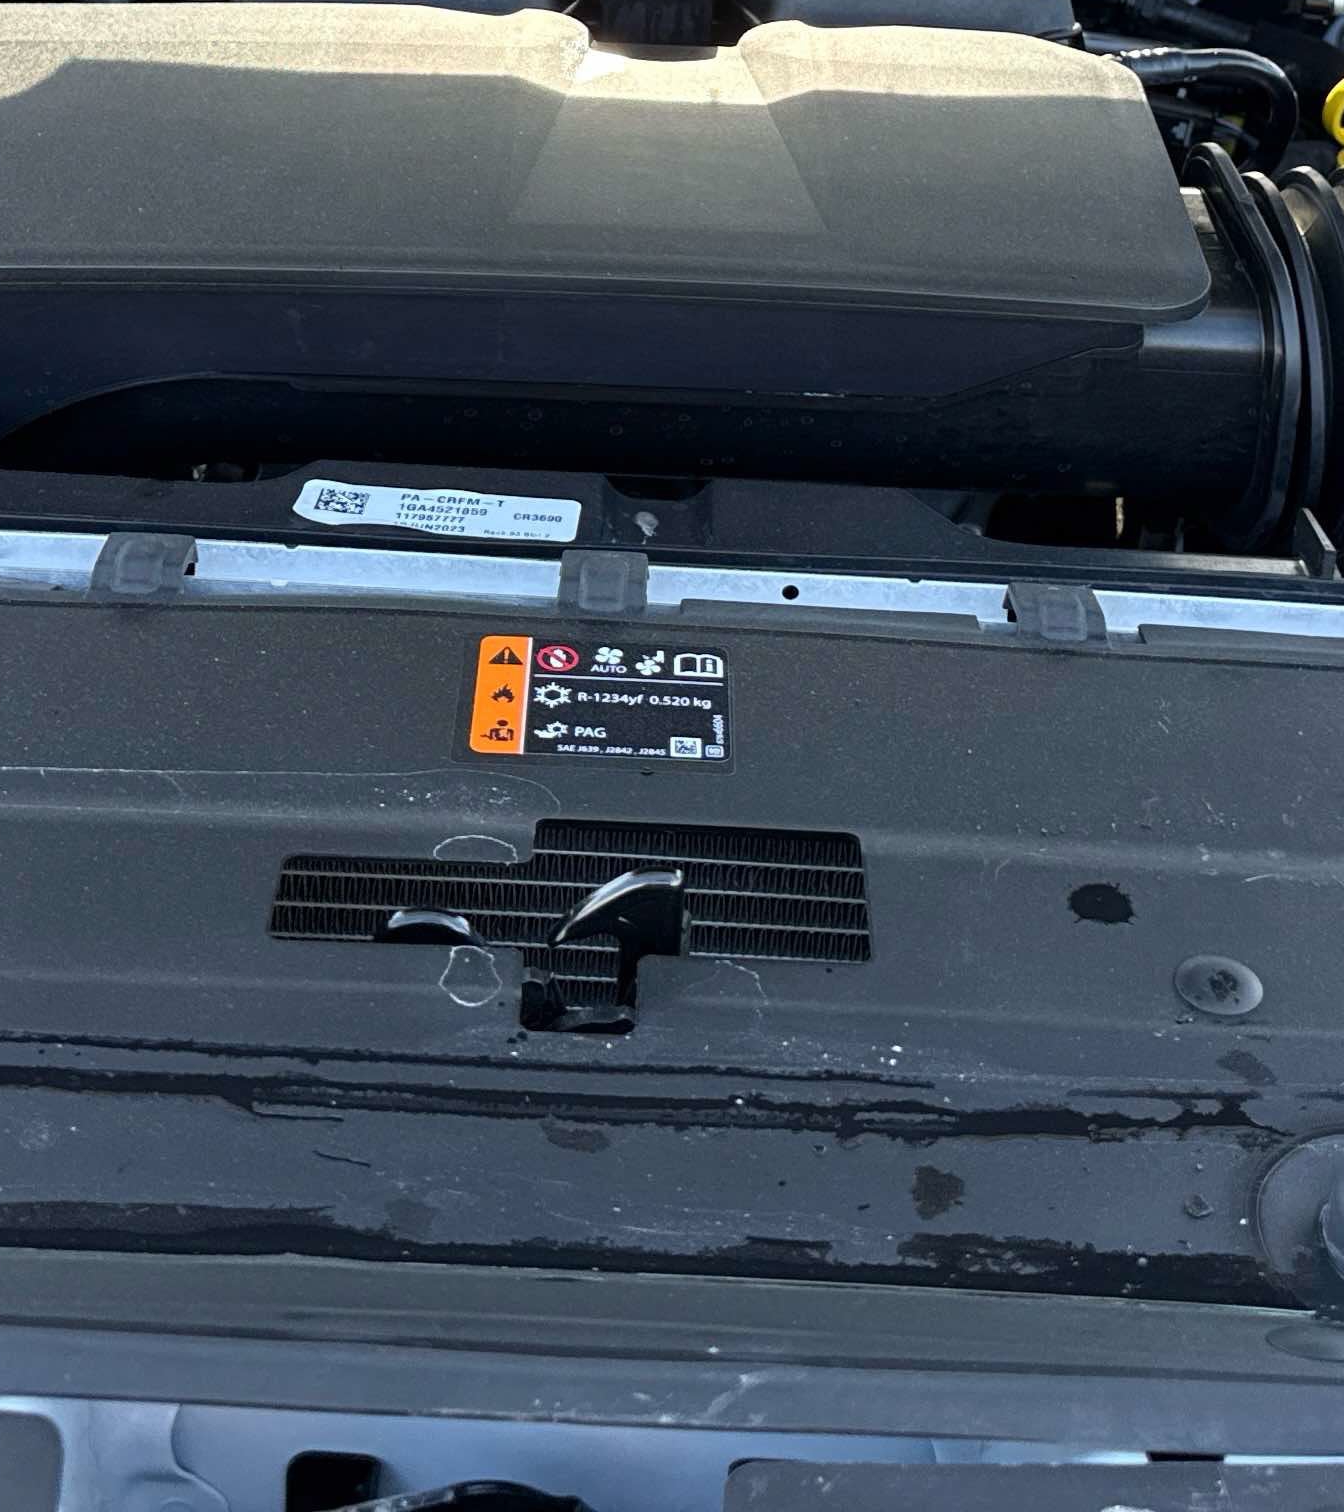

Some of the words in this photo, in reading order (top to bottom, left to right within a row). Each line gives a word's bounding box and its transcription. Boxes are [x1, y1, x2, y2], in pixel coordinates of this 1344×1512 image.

[590, 663, 627, 674] AUTO
[577, 692, 644, 706] R-1234yf
[649, 695, 690, 706] 0.520
[692, 697, 712, 709] kg
[574, 726, 607, 738] PAG
[556, 744, 576, 752] SAE
